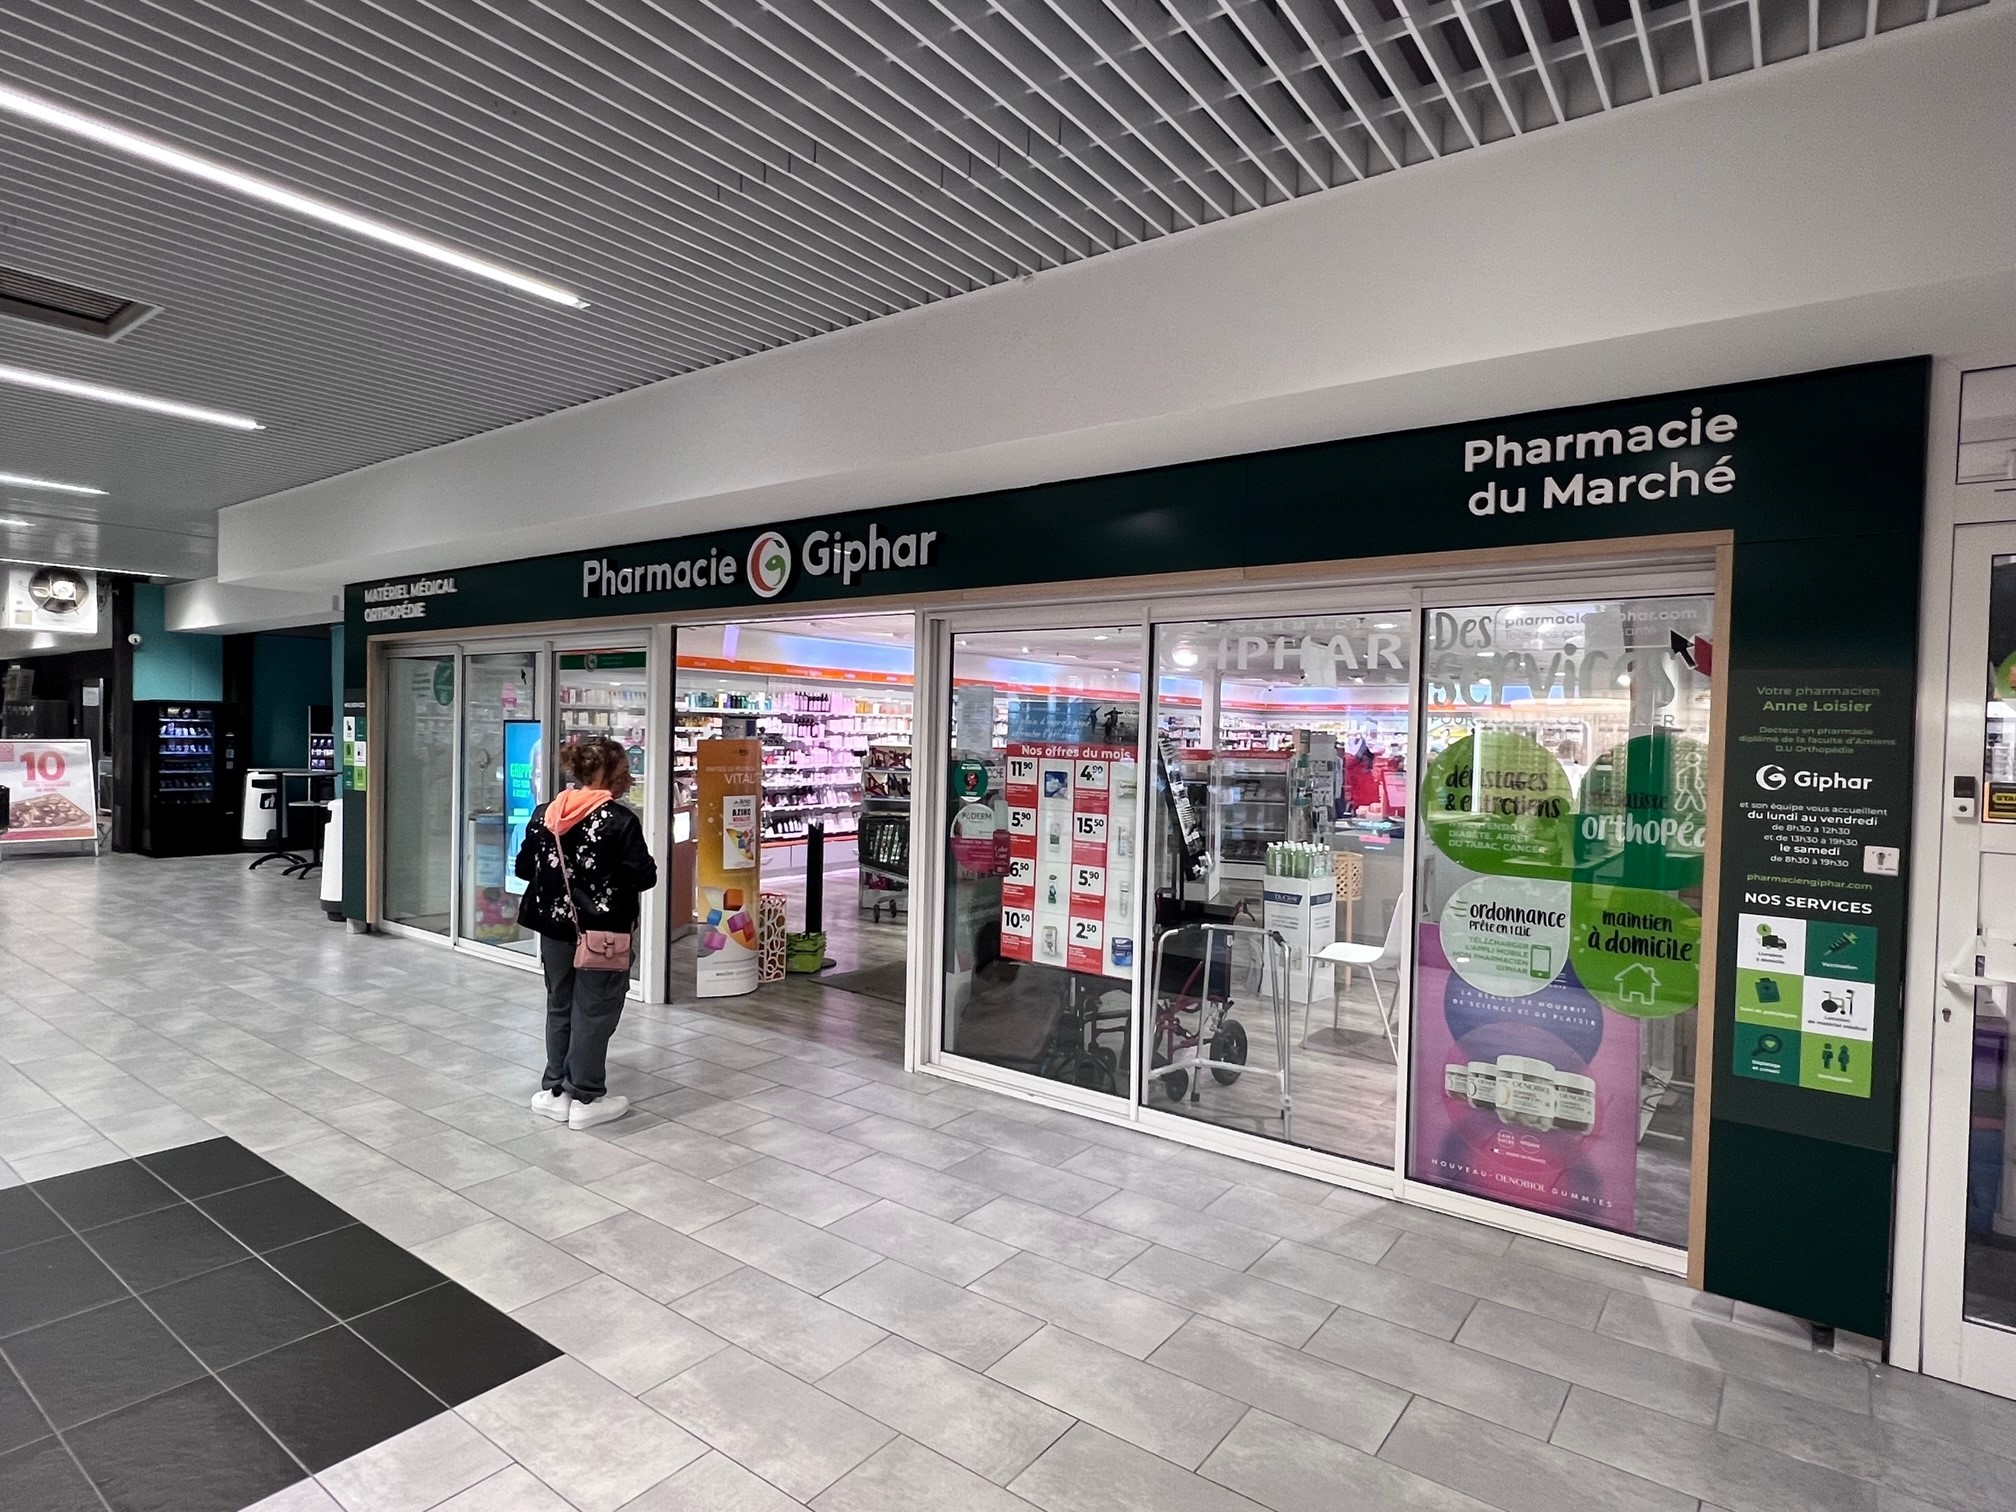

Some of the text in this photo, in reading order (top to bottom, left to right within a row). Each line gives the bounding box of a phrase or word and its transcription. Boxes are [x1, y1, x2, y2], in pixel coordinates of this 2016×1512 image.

[1464, 407, 1738, 472] Pharmacie
[1468, 455, 1736, 516] du Marché
[583, 523, 937, 598] Pharmacie Giphar
[411, 578, 458, 597] MÉDICAL
[1434, 611, 1492, 650] Des
[1756, 686, 1880, 697] Votre pharmacien
[1762, 700, 1872, 712] Anne Loisier
[1759, 726, 1799, 734] Docteur
[1817, 727, 1873, 736] pharmacie
[1021, 745, 1042, 756] Nos
[1045, 746, 1079, 757] offres
[1082, 747, 1098, 758] du
[20, 751, 66, 781] 10
[1794, 770, 1873, 792] Giphar
[1445, 793, 1457, 811] &
[1770, 803, 1804, 812] équipe
[1832, 806, 1888, 816] accueillent
[1748, 810, 1878, 826] du lundi au vendredi
[1786, 825, 1811, 833] 8h30
[1822, 827, 1850, 835] 12h30
[1776, 834, 1788, 842] de
[1791, 835, 1818, 844] 13h30
[1829, 838, 1858, 846] 19h30
[1780, 843, 1840, 856] le samedi
[1785, 856, 1810, 864] 8h30
[1820, 858, 1849, 867] 19h30
[1746, 873, 1873, 891] pharmaciengiphar.com
[1744, 892, 1873, 914] NOS SERVICES
[1470, 901, 1566, 928] ordonnance
[1602, 910, 1672, 933] maintien
[1588, 925, 1693, 961] à domicile
[1431, 1158, 1487, 1177] NOUVEAU
[1552, 1188, 1612, 1208] GUMMIES
